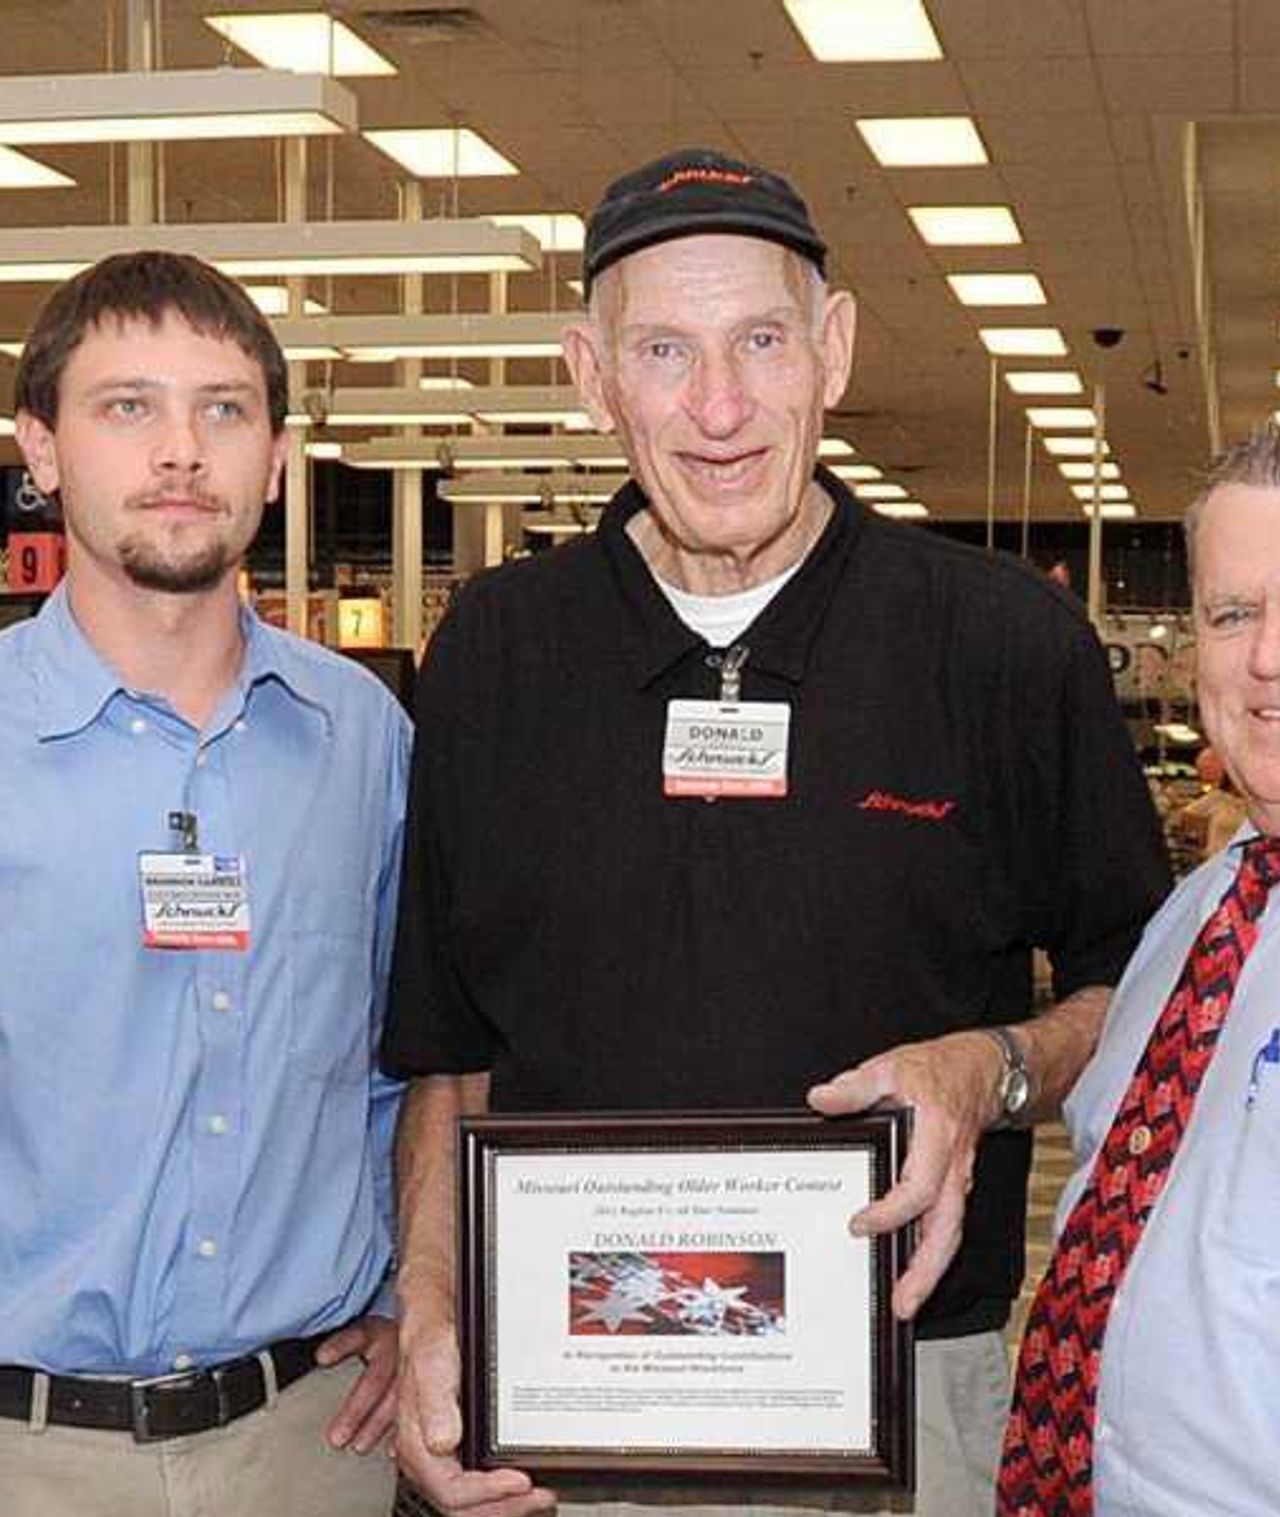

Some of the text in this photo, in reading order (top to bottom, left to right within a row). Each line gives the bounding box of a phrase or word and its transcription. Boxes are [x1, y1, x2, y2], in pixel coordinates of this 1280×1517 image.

[22, 545, 38, 584] 9
[594, 1232, 778, 1248] DONALD ROBINSON
